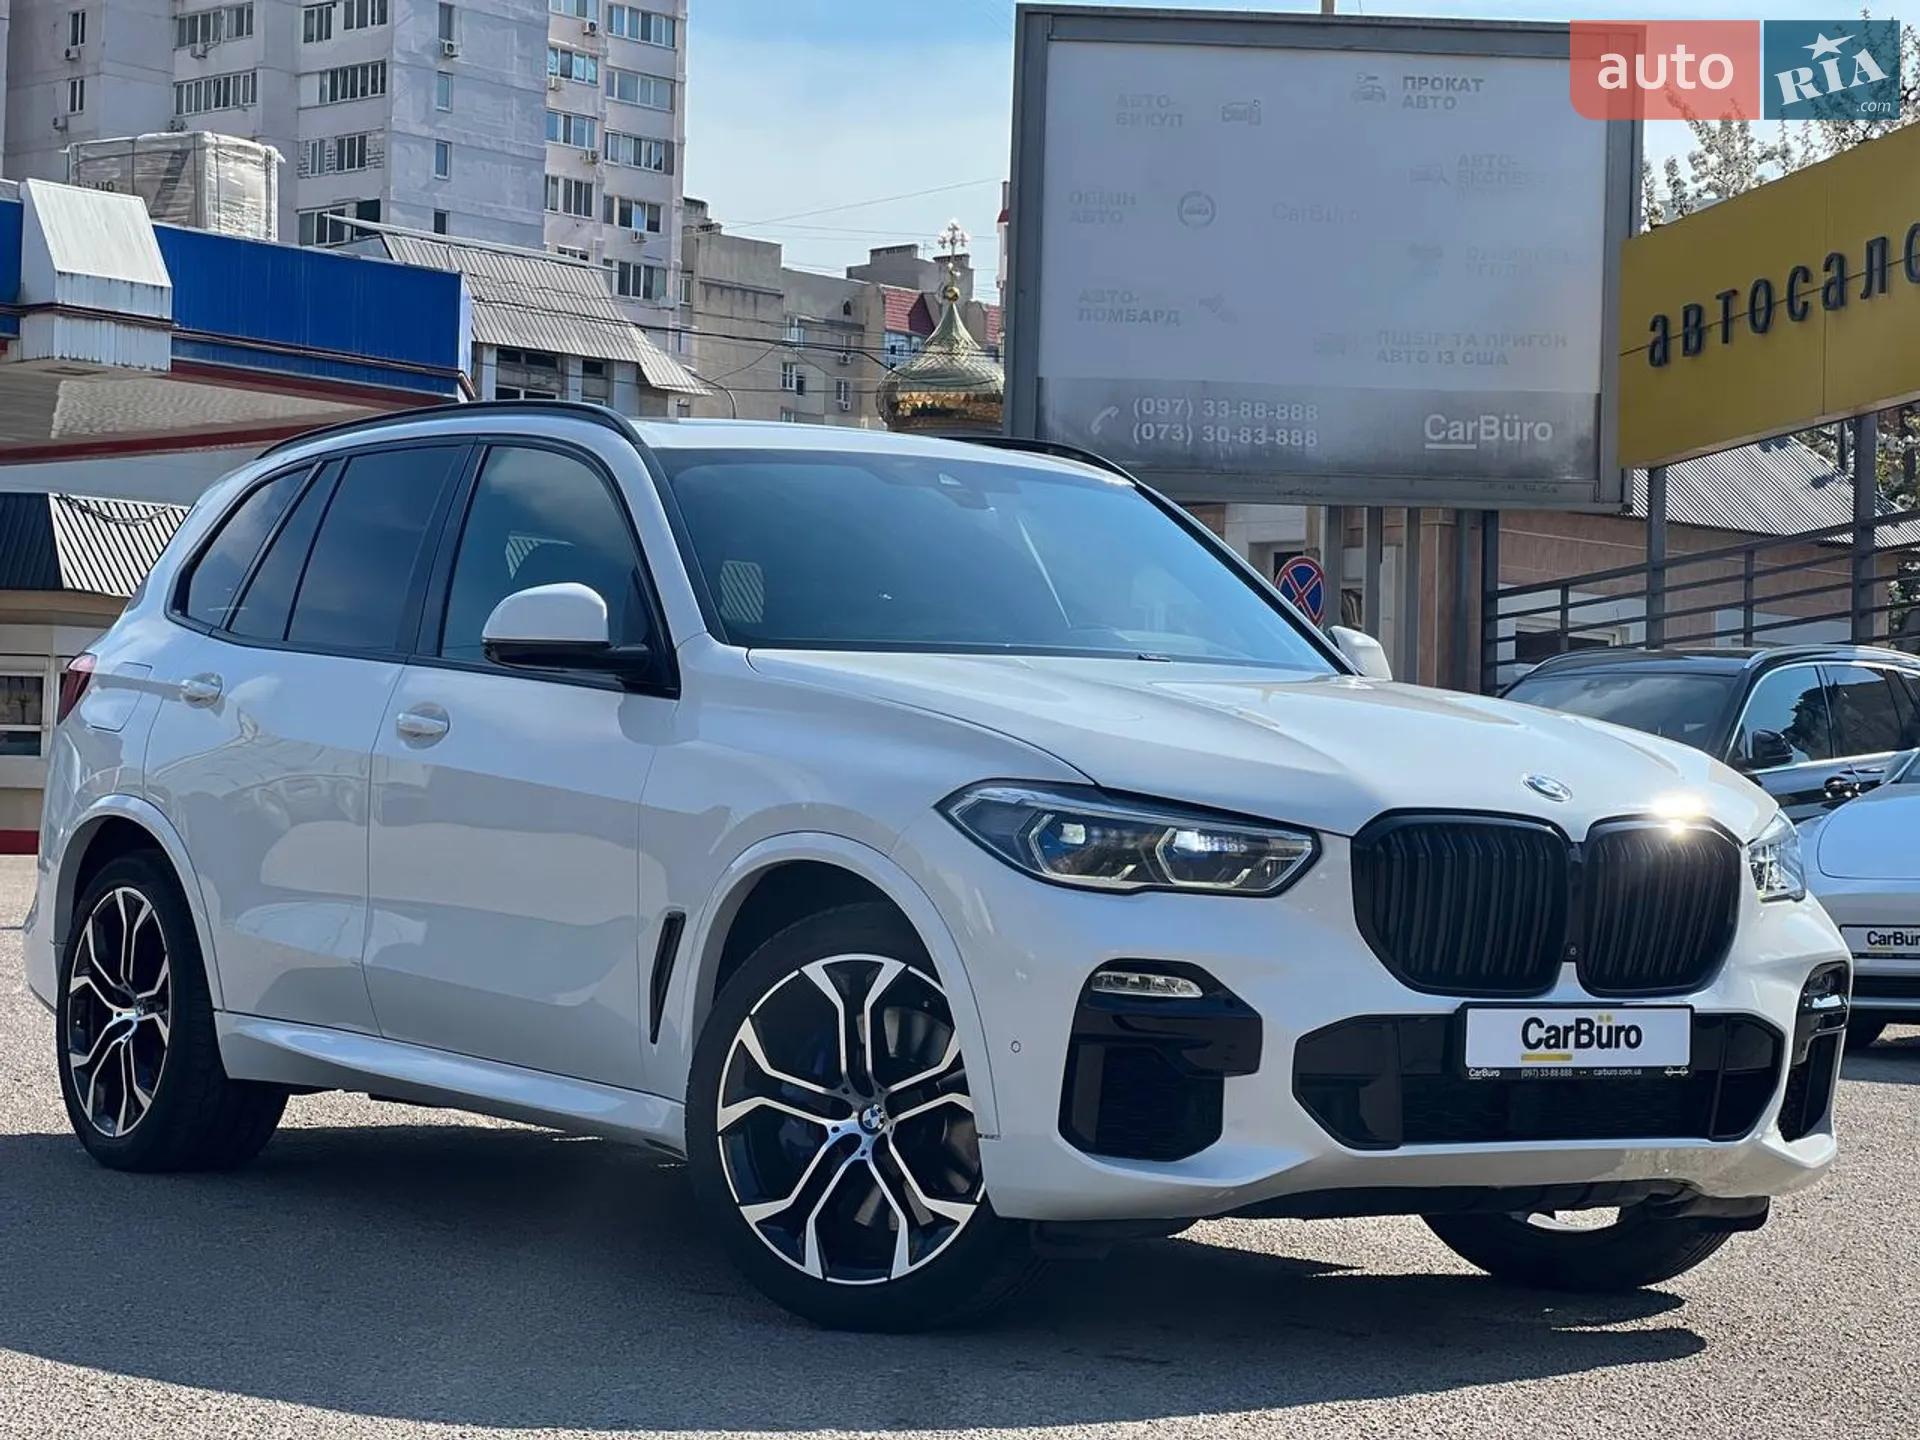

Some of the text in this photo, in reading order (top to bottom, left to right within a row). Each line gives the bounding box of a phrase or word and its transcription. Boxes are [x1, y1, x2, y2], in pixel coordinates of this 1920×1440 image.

[1402, 76, 1484, 93] ПРОКАТ
[1401, 95, 1458, 111] АВТО
[1375, 350, 1430, 366] АВТО
[1462, 351, 1510, 367] США
[1132, 396, 1319, 422] (097) 33-88-888
[1131, 420, 1318, 447] (073) 30-83-888
[1424, 412, 1553, 442] CarBüro
[1521, 1014, 1642, 1050] CarBüro
